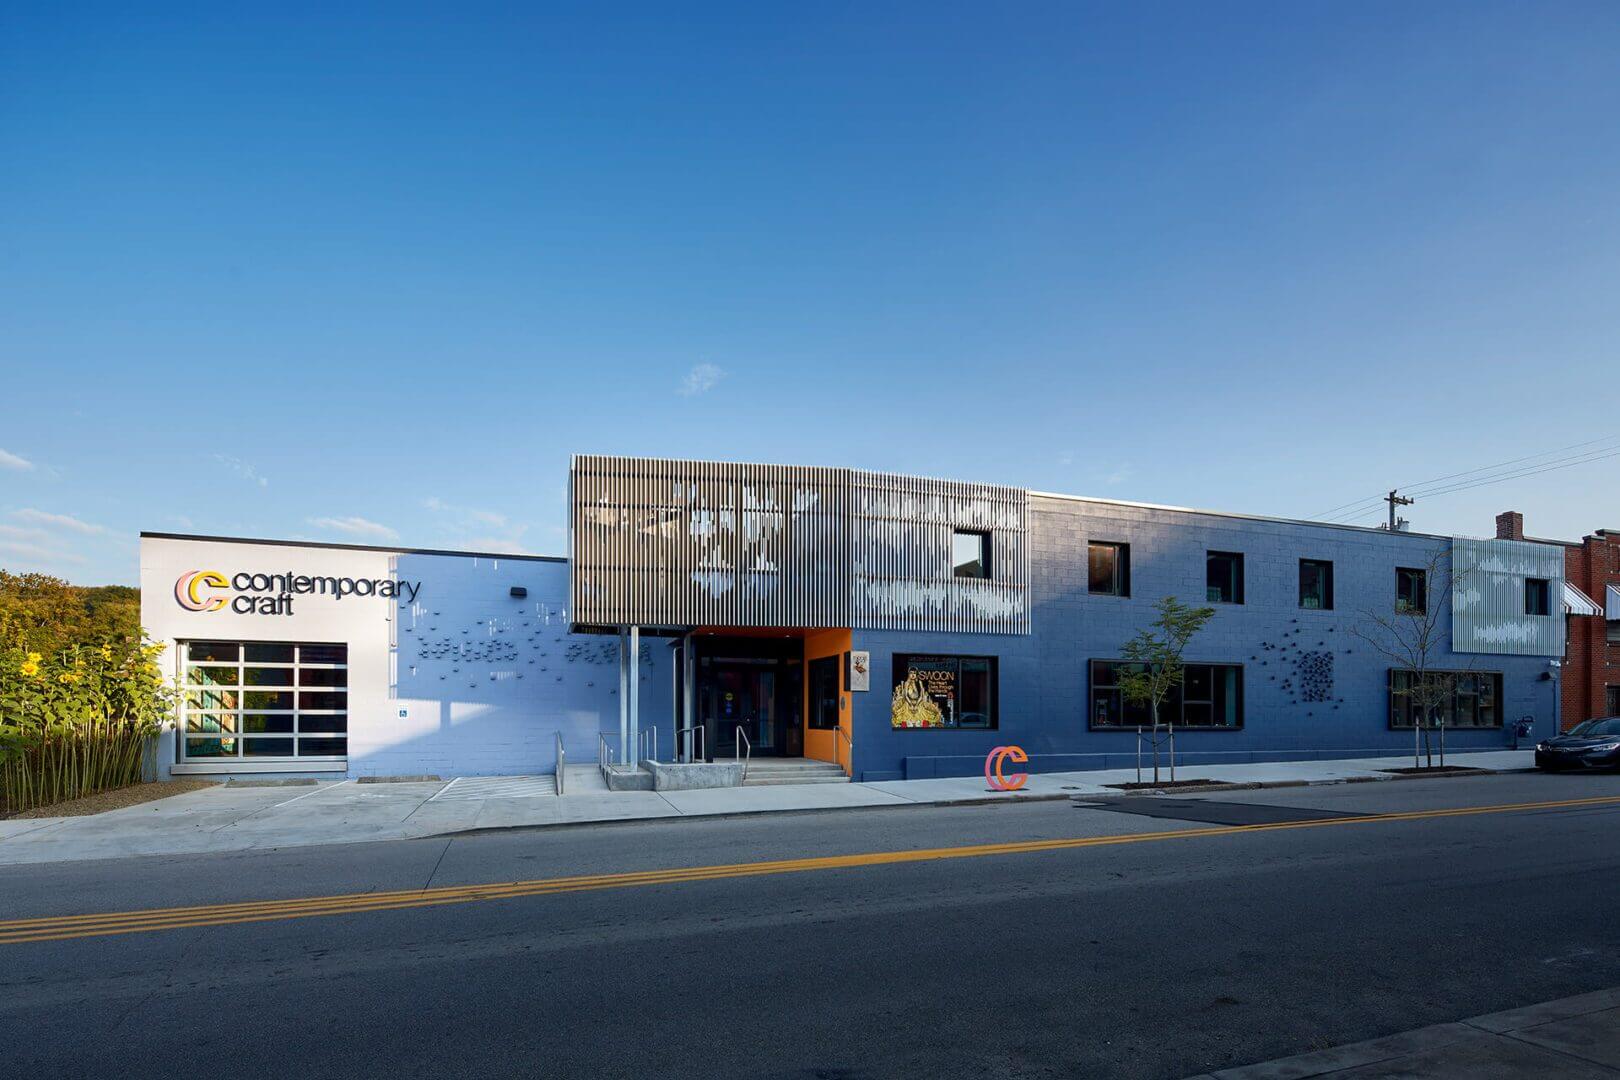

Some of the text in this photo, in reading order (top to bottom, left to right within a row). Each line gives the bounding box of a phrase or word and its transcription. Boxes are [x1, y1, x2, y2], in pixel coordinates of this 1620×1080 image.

[231, 571, 421, 602] contemporary
[231, 592, 294, 616] craft
[918, 671, 955, 681] SWOON
